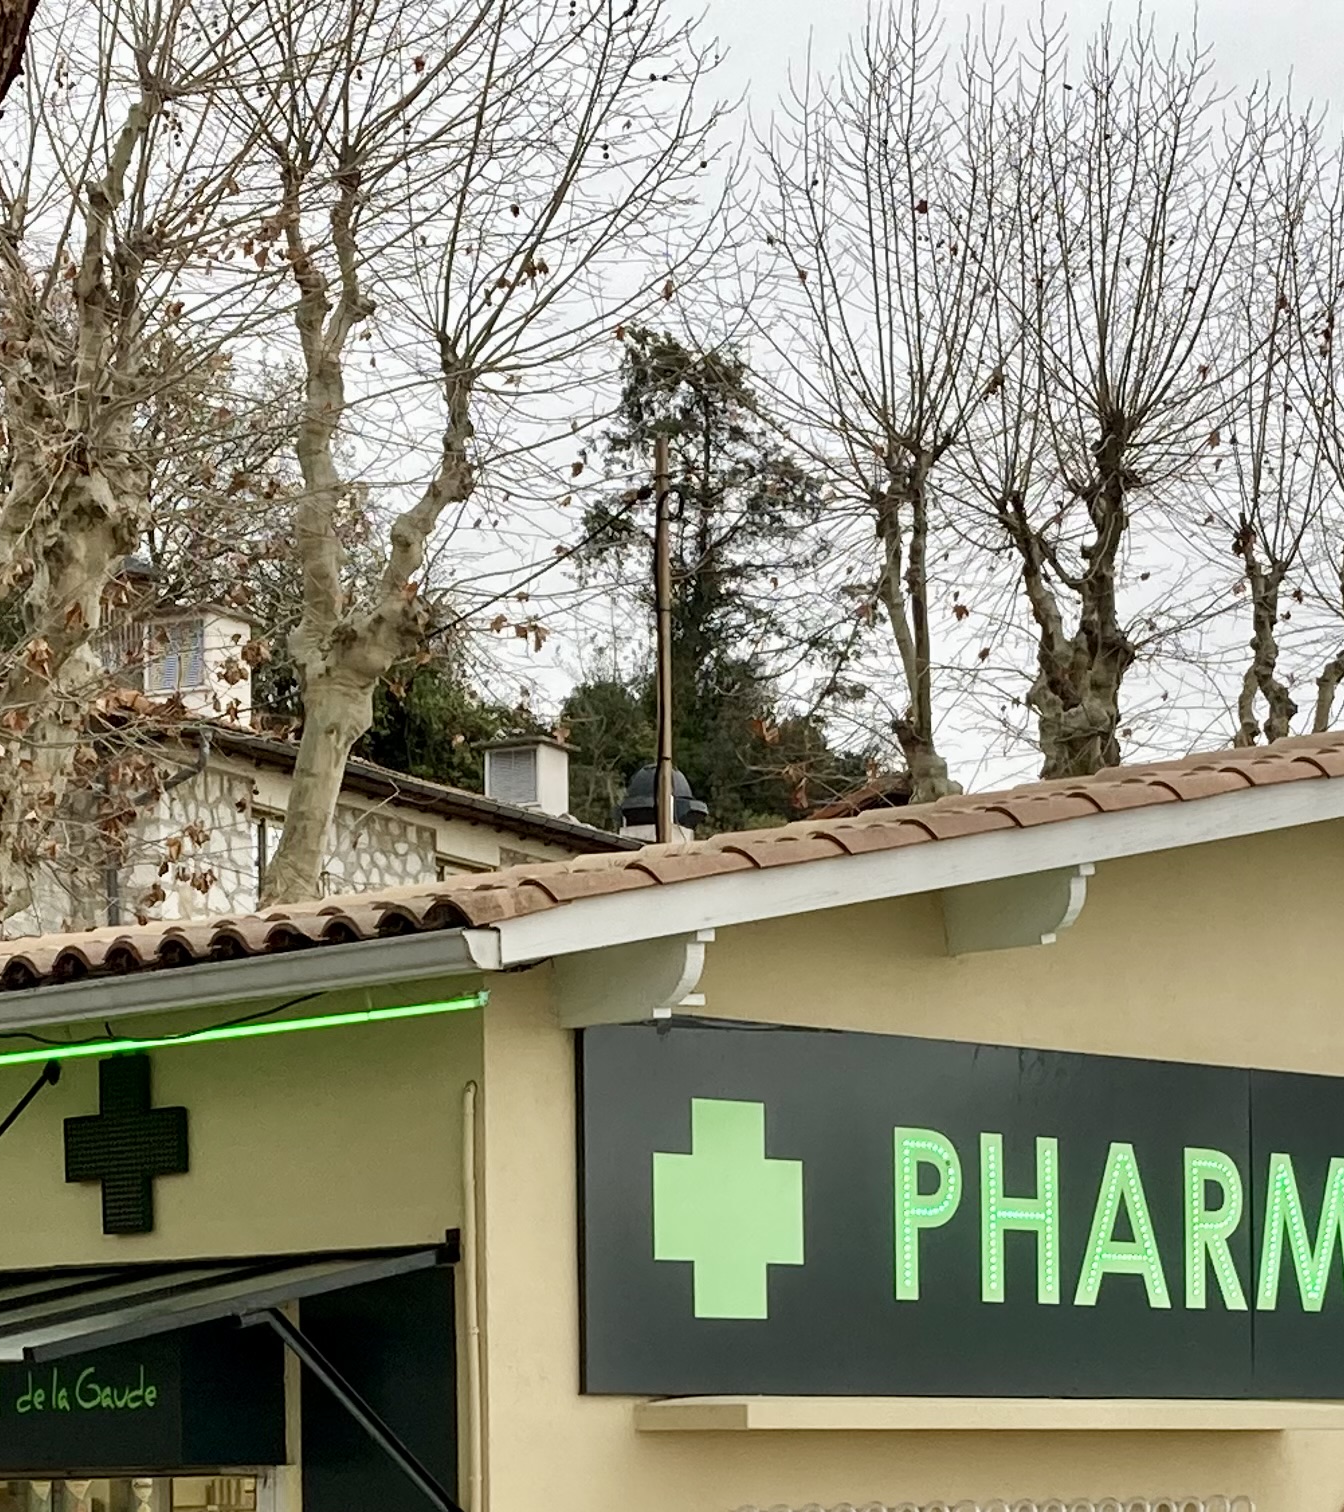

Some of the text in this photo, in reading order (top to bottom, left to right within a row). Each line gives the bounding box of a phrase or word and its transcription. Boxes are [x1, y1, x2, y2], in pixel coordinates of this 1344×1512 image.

[16, 1370, 45, 1413] de
[52, 1367, 71, 1412] la
[75, 1364, 157, 1409] Gaude
